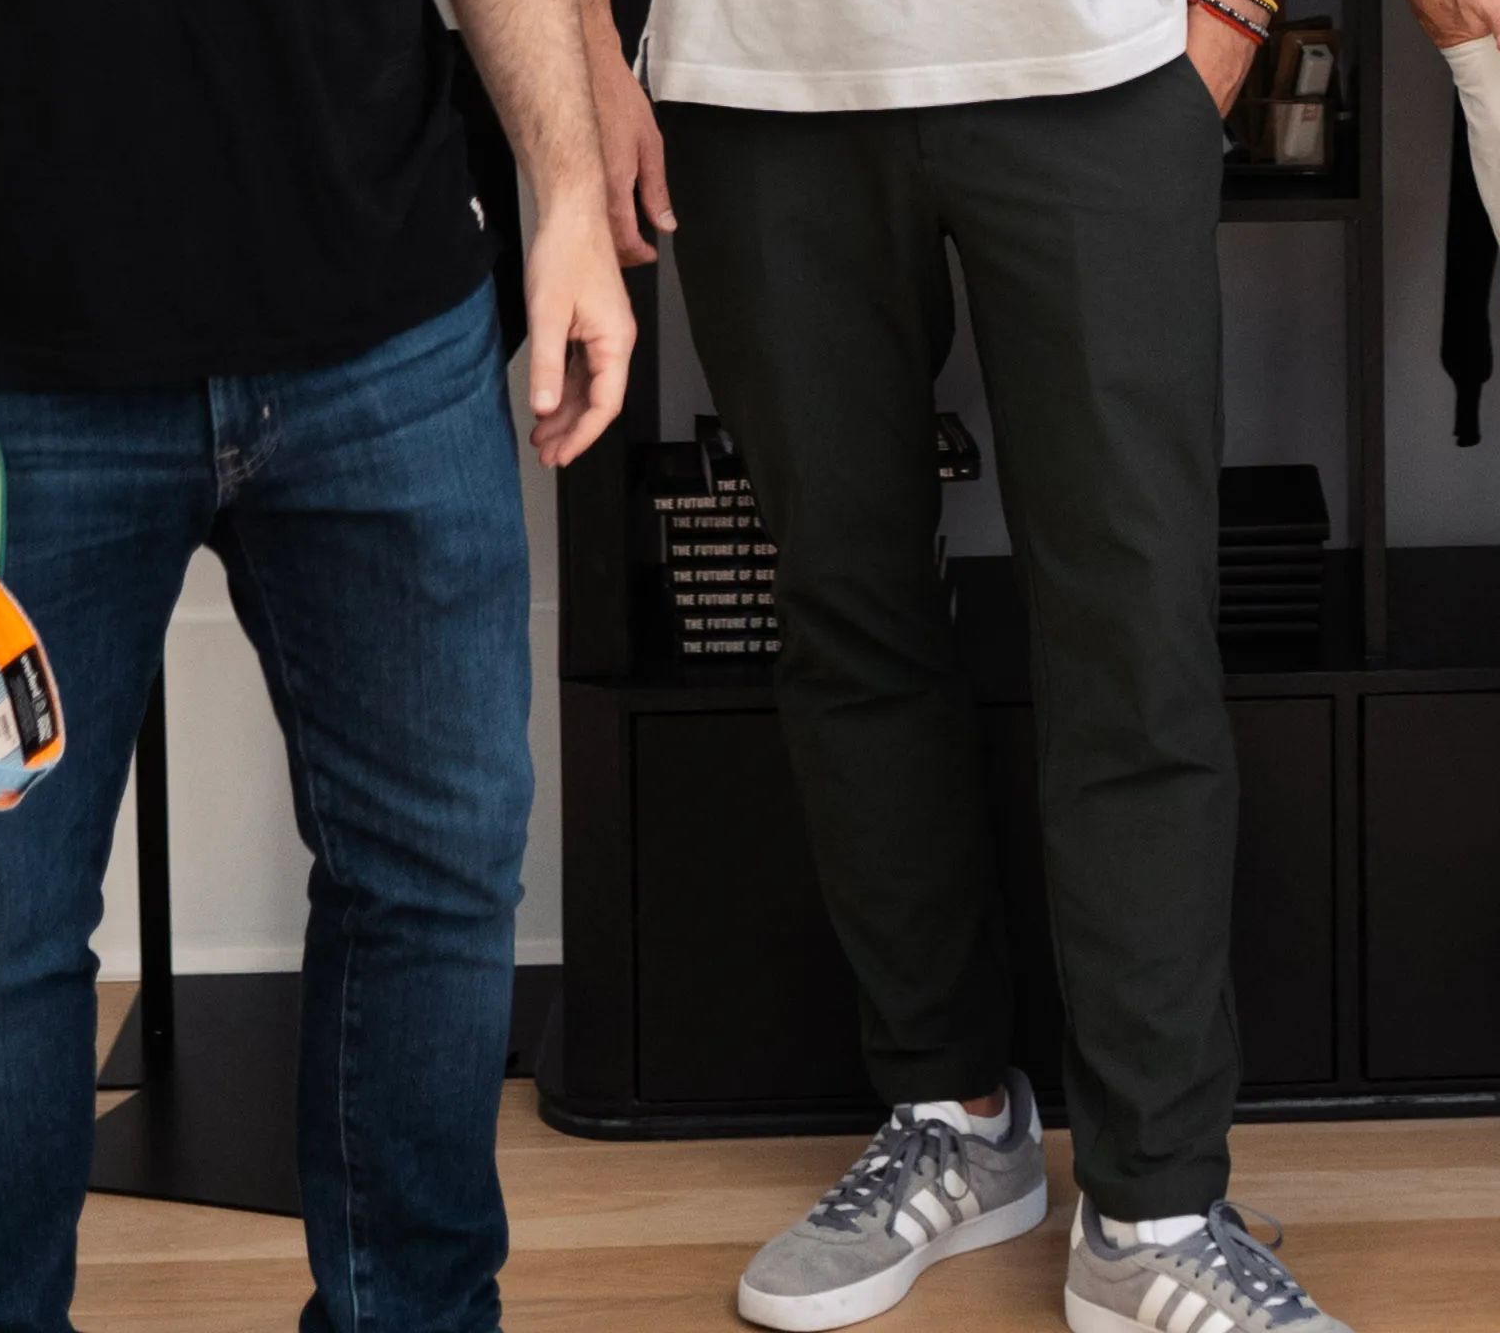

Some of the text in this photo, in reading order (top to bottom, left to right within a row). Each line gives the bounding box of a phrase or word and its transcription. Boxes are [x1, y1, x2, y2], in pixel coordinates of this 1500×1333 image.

[717, 479, 737, 492] THE
[653, 498, 674, 510] THE
[677, 496, 717, 509] FUTURE
[720, 496, 734, 508] OF
[672, 516, 692, 528] THE
[694, 516, 734, 528] FUTURE
[737, 516, 751, 528] OF
[672, 544, 691, 556] THE
[694, 544, 734, 556] FUTURE
[737, 544, 751, 556] OF
[673, 570, 693, 582] THE
[695, 570, 736, 581] FUTURE
[738, 569, 752, 581] OF
[675, 593, 695, 606] THE
[698, 593, 738, 605] FUTURE
[741, 593, 755, 605] OF
[684, 618, 704, 630] THE
[706, 617, 747, 630] FUTURE
[750, 617, 763, 629] OF
[683, 641, 702, 653] THE
[705, 640, 745, 653] FUTURE
[748, 640, 762, 652] OF
